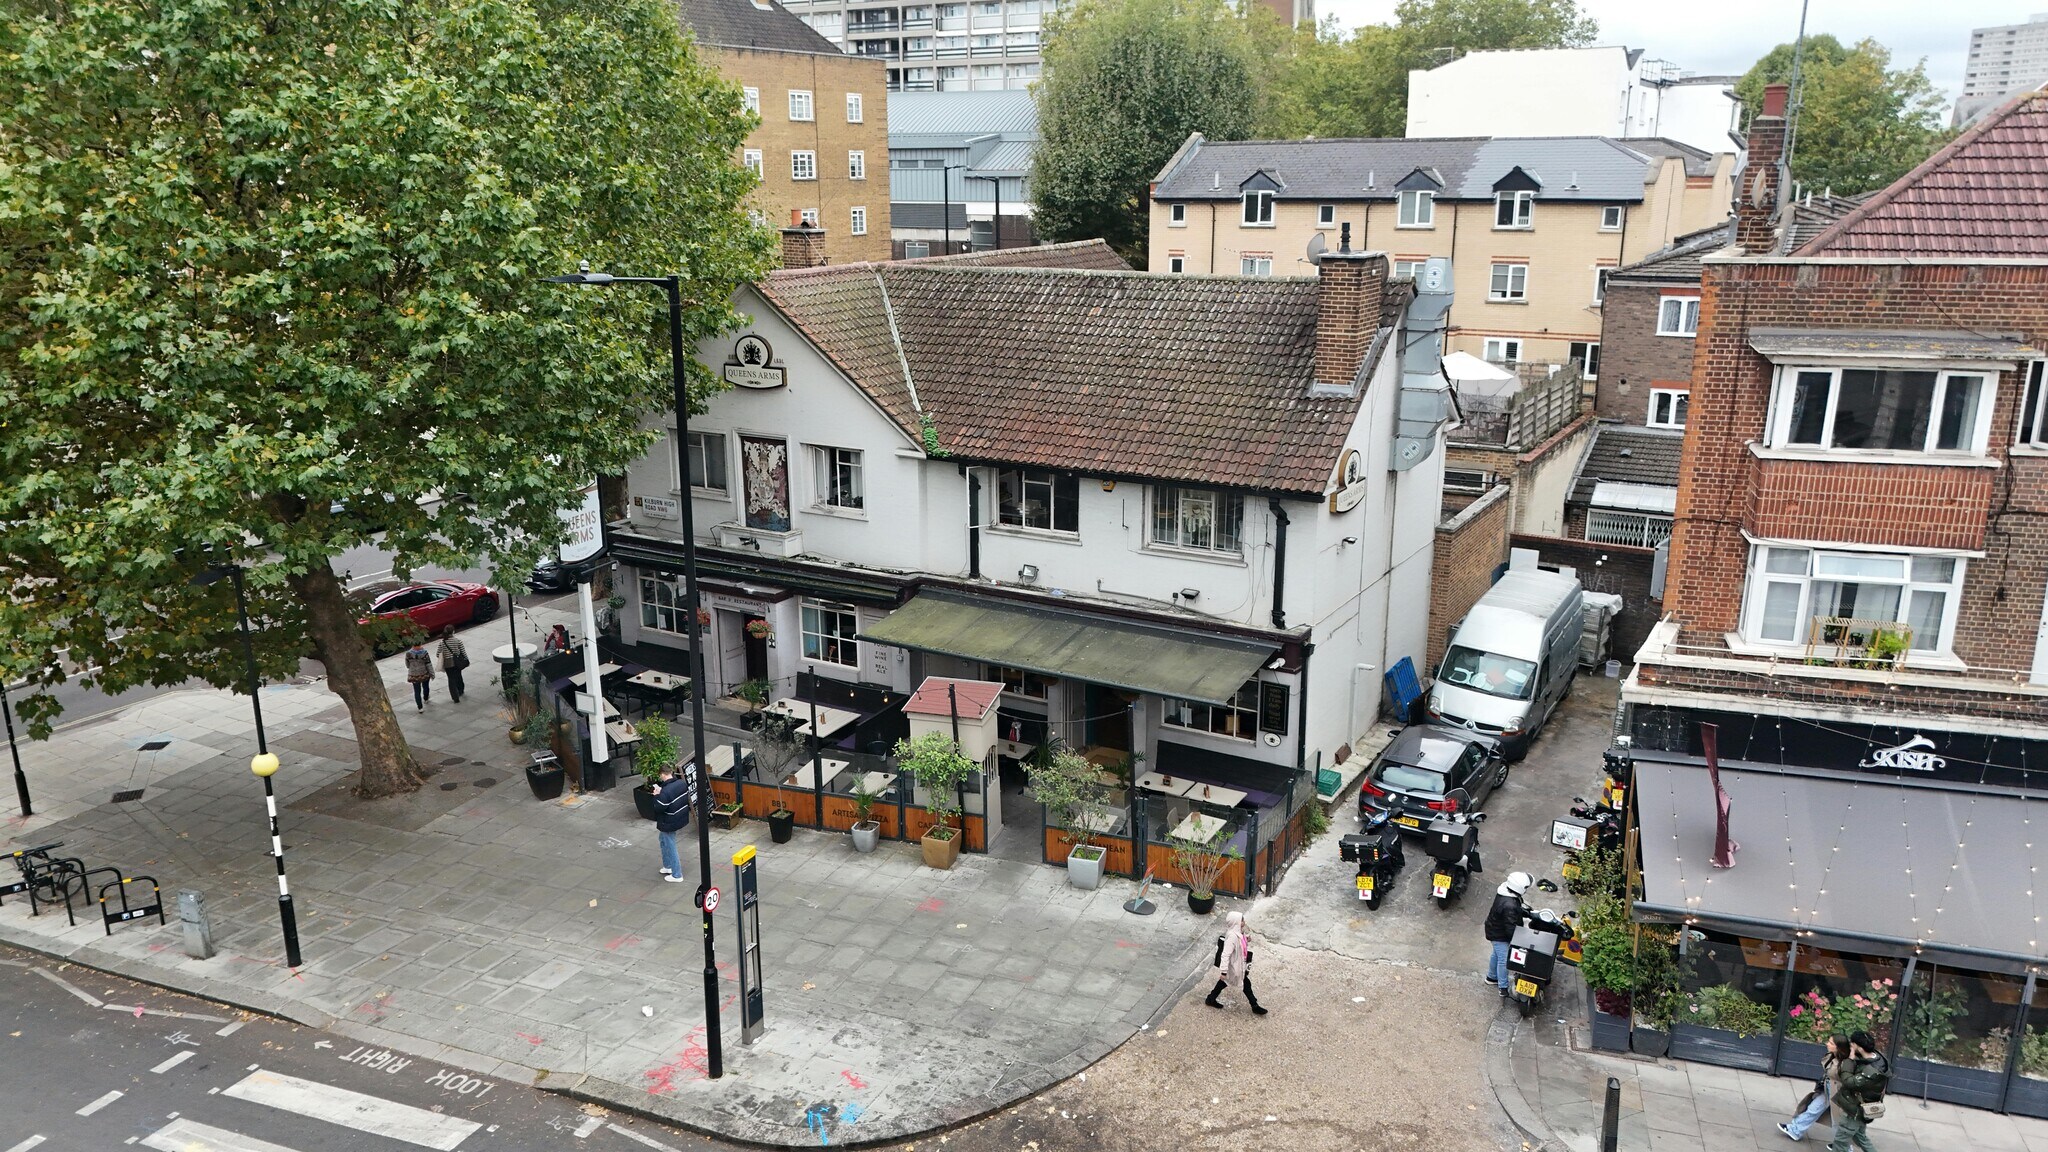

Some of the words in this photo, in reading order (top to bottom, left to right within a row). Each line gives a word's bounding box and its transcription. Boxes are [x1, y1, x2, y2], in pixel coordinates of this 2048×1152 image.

[728, 369, 757, 378] QUEENS
[758, 372, 780, 380] ARMS
[644, 498, 663, 506] KILBURN
[1362, 889, 1368, 897] L
[1436, 886, 1443, 894] L
[707, 893, 718, 907] 20
[1514, 952, 1521, 961] L
[338, 1046, 412, 1074] RIGHT
[425, 1069, 497, 1098] LOOK
